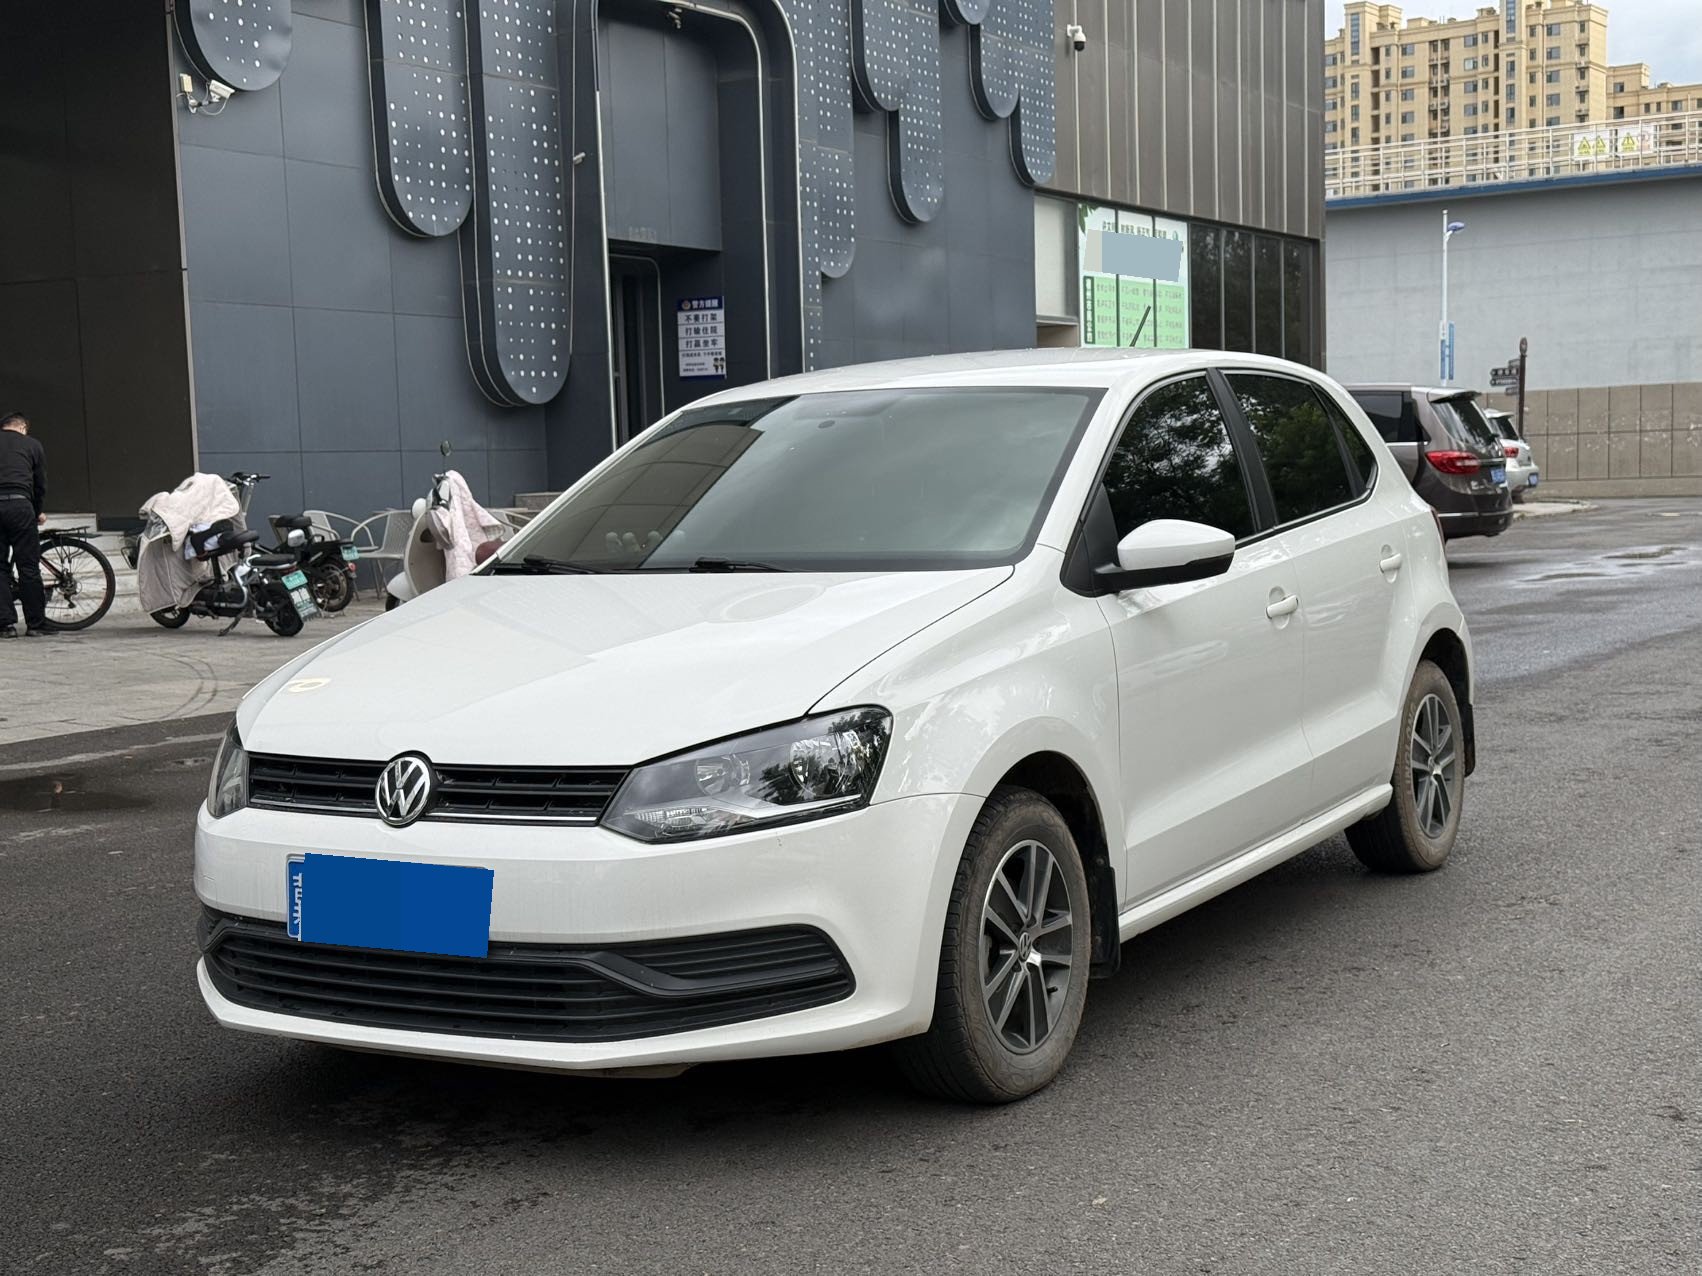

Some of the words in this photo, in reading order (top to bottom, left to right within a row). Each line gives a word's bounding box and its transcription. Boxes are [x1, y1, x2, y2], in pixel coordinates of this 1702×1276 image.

[685, 313, 717, 323] 不要打架
[375, 757, 431, 826] VW
